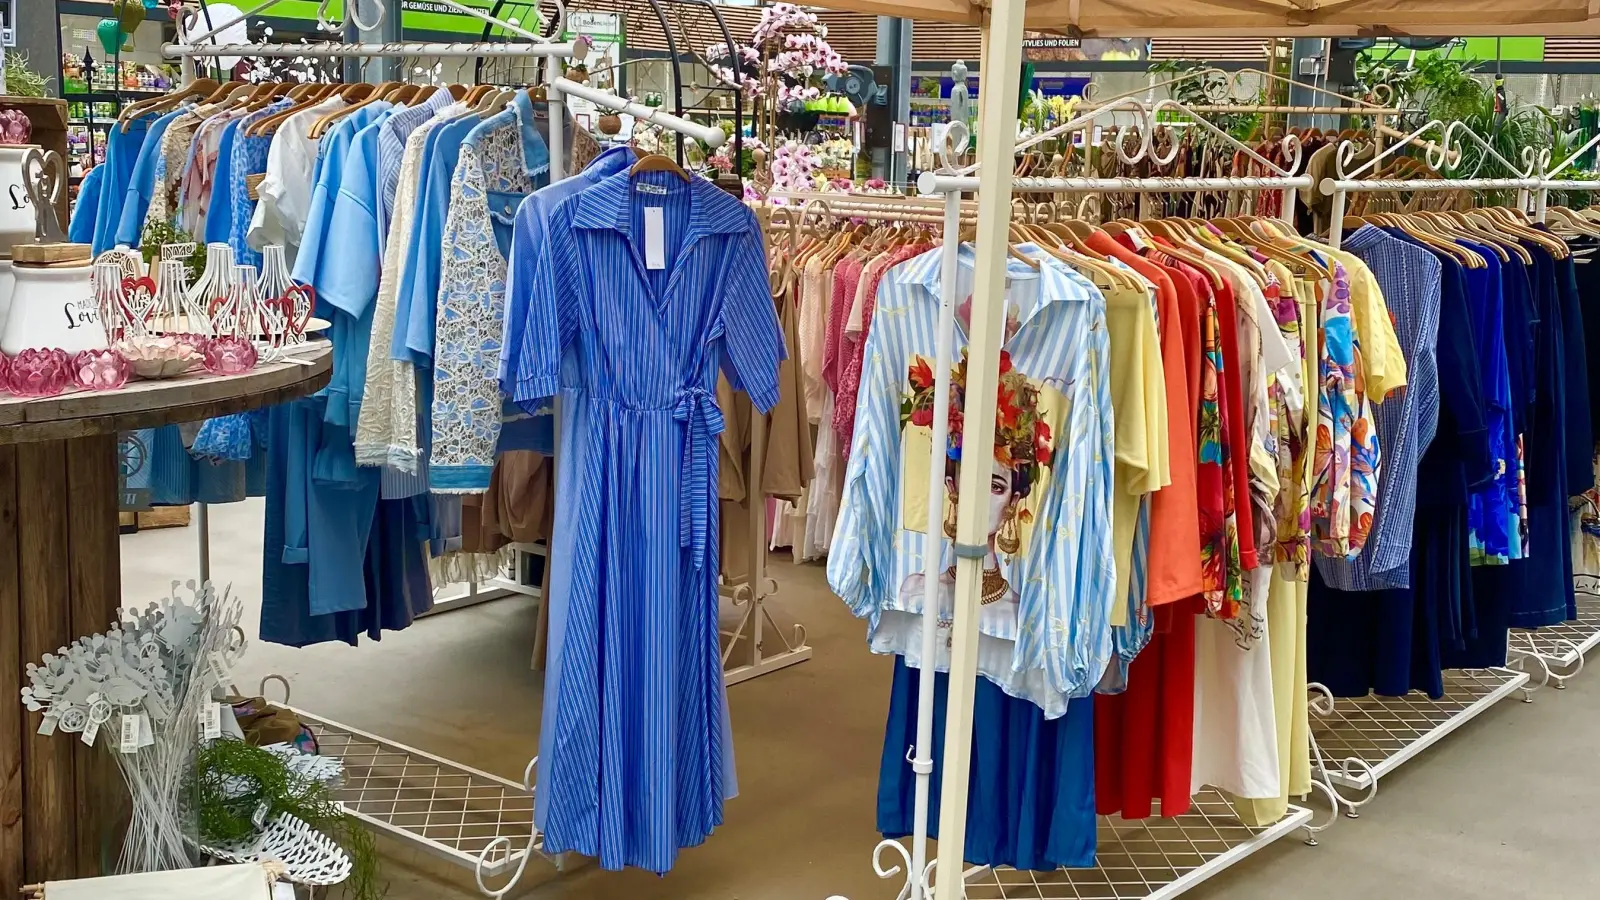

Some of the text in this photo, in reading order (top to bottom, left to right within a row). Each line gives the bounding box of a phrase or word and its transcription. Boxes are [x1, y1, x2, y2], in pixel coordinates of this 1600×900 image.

[408, 2, 433, 11] GEMÜSE
[434, 4, 448, 12] UND
[1044, 39, 1057, 47] UND
[1058, 39, 1079, 47] FOLIEN
